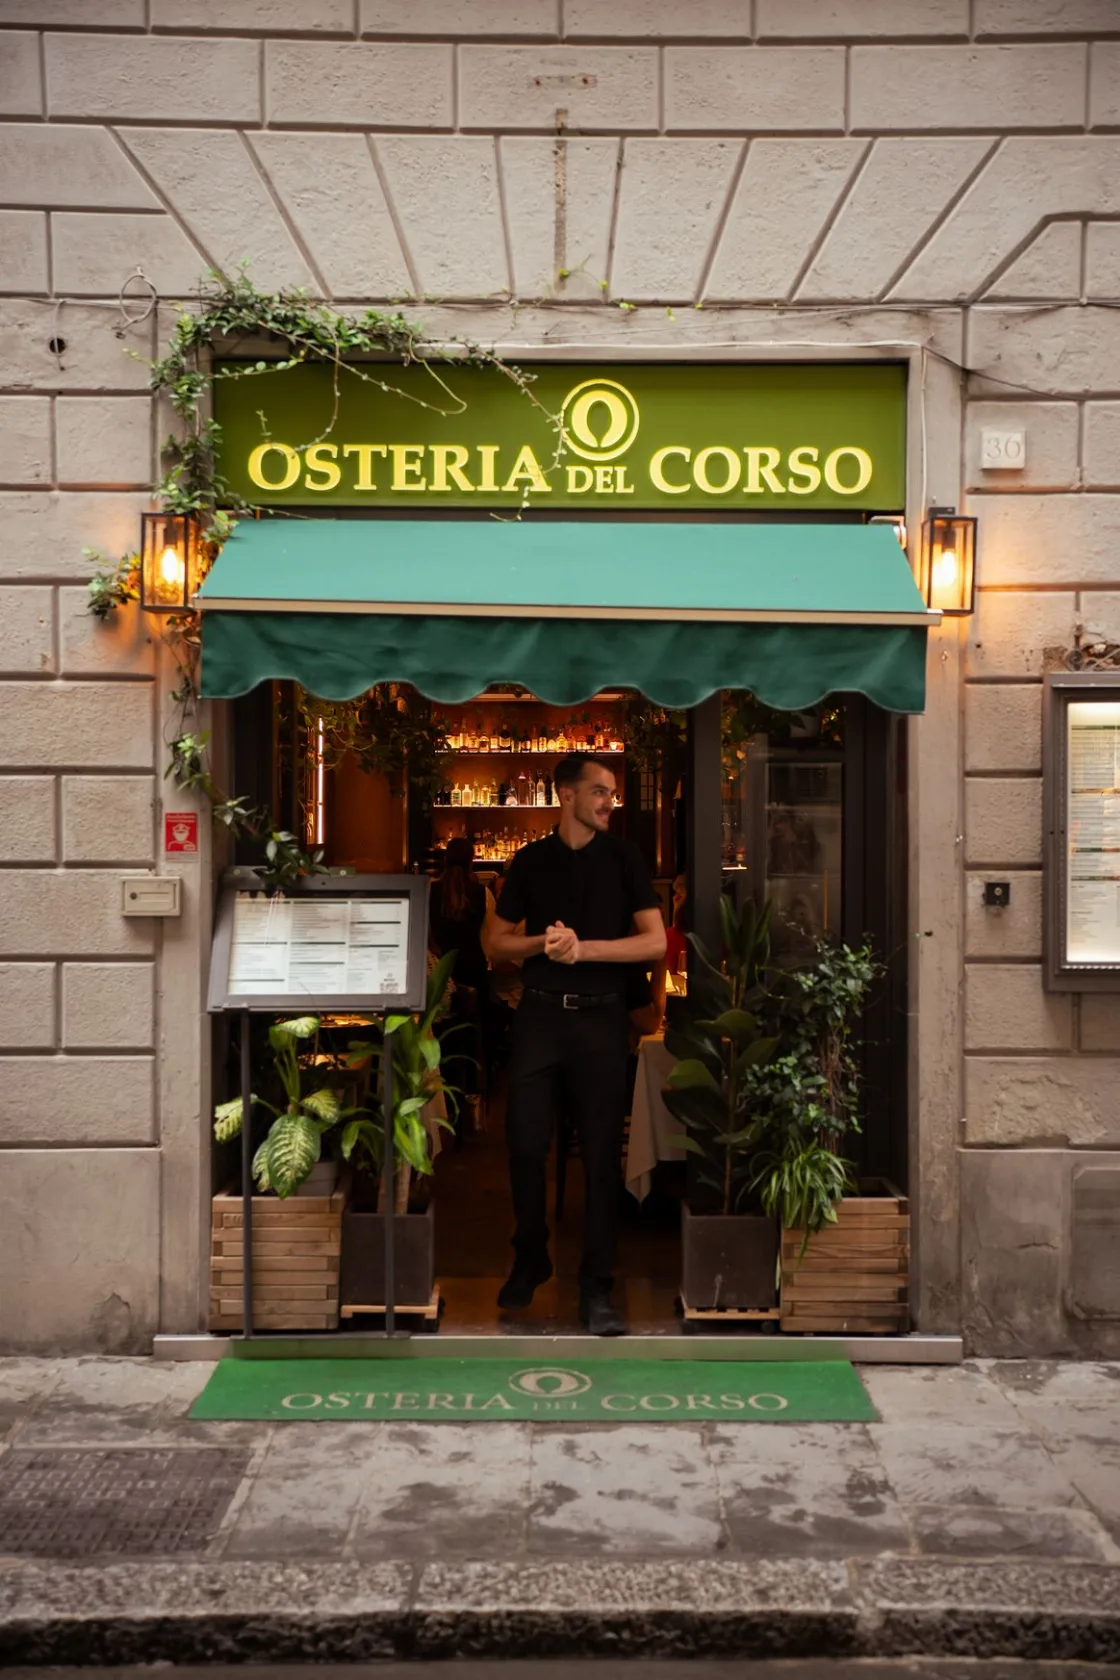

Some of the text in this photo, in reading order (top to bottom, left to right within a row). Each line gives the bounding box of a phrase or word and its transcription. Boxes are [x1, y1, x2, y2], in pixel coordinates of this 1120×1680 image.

[986, 434, 1021, 460] 36
[247, 442, 873, 495] OSTERIA DEL CORSO
[281, 1391, 789, 1411] OSTERIA DEL CORSO
